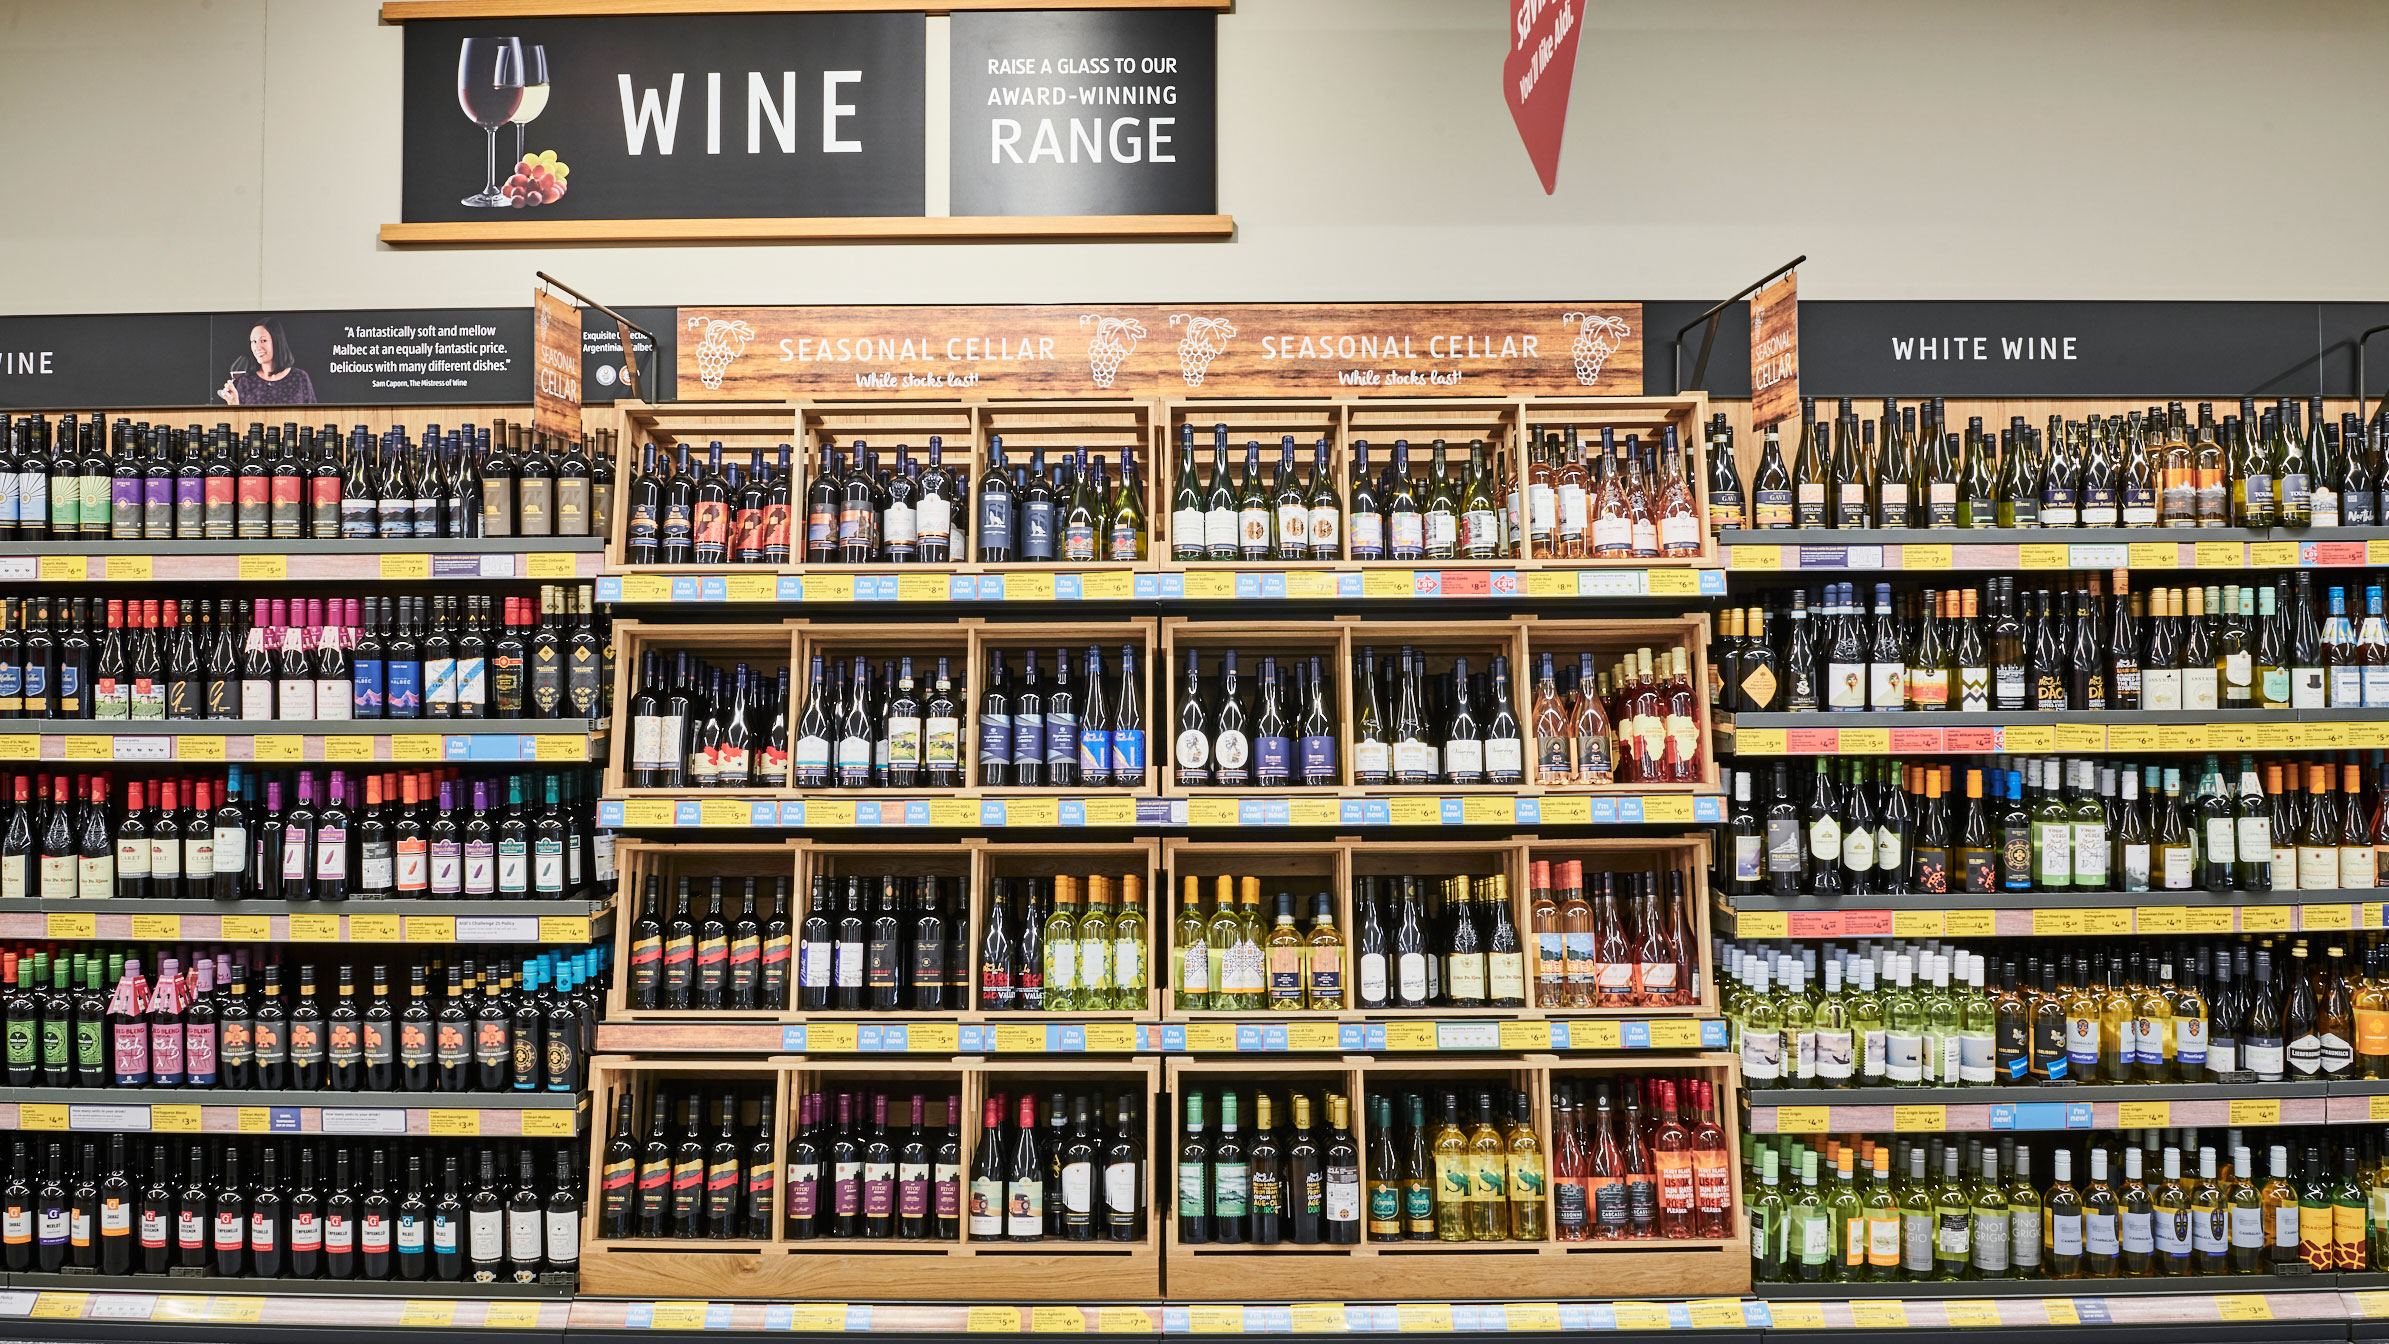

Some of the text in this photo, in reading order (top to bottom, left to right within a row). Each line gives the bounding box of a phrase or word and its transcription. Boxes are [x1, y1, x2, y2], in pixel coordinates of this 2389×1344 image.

[1539, 34, 1553, 75] like
[988, 57, 1177, 75] RAISE A GLASS TO OUR
[987, 86, 1177, 106] AWARD-WINNING
[617, 70, 862, 155] WINE
[991, 116, 1176, 164] RANGE
[356, 326, 416, 340] fantastically
[418, 325, 438, 337] soft
[438, 325, 457, 337] and
[459, 325, 496, 337] mellow
[583, 331, 616, 341] Exquisite
[333, 342, 508, 357] Malbec at an equally fantastic price.
[583, 343, 653, 354] Argentinia albec
[779, 338, 1055, 361] SEASONAL CELLAR
[1262, 336, 1539, 360] SEASONAL CELLAR
[1755, 330, 1791, 363] SEASONAL
[1891, 336, 2078, 361] WHITE WINE
[0, 352, 53, 375] INE
[330, 361, 373, 373] Delicious
[375, 361, 397, 372] with
[399, 362, 426, 374] many
[428, 360, 471, 372] different
[541, 345, 576, 375] SEASONAL
[1338, 370, 1462, 386] While stocks last!
[1755, 352, 1792, 391] CELLAR
[372, 380, 385, 388] Sam
[386, 380, 409, 388] Caporn,
[410, 379, 421, 387] The
[421, 379, 445, 387] Mistress
[541, 368, 577, 403] CELLAR
[856, 372, 979, 388] While stocks last!
[1497, 580, 1514, 588] LOW
[2070, 1114, 2088, 1122] new!
[108, 1201, 117, 1209] G
[9, 1209, 18, 1217] G
[49, 1210, 59, 1218] G
[146, 1212, 153, 1220] G
[222, 1215, 230, 1223] G
[332, 1217, 339, 1226] G
[404, 1218, 411, 1226] G
[1974, 1219, 2003, 1232] PINOT
[1974, 1230, 2008, 1242] GRIGIO
